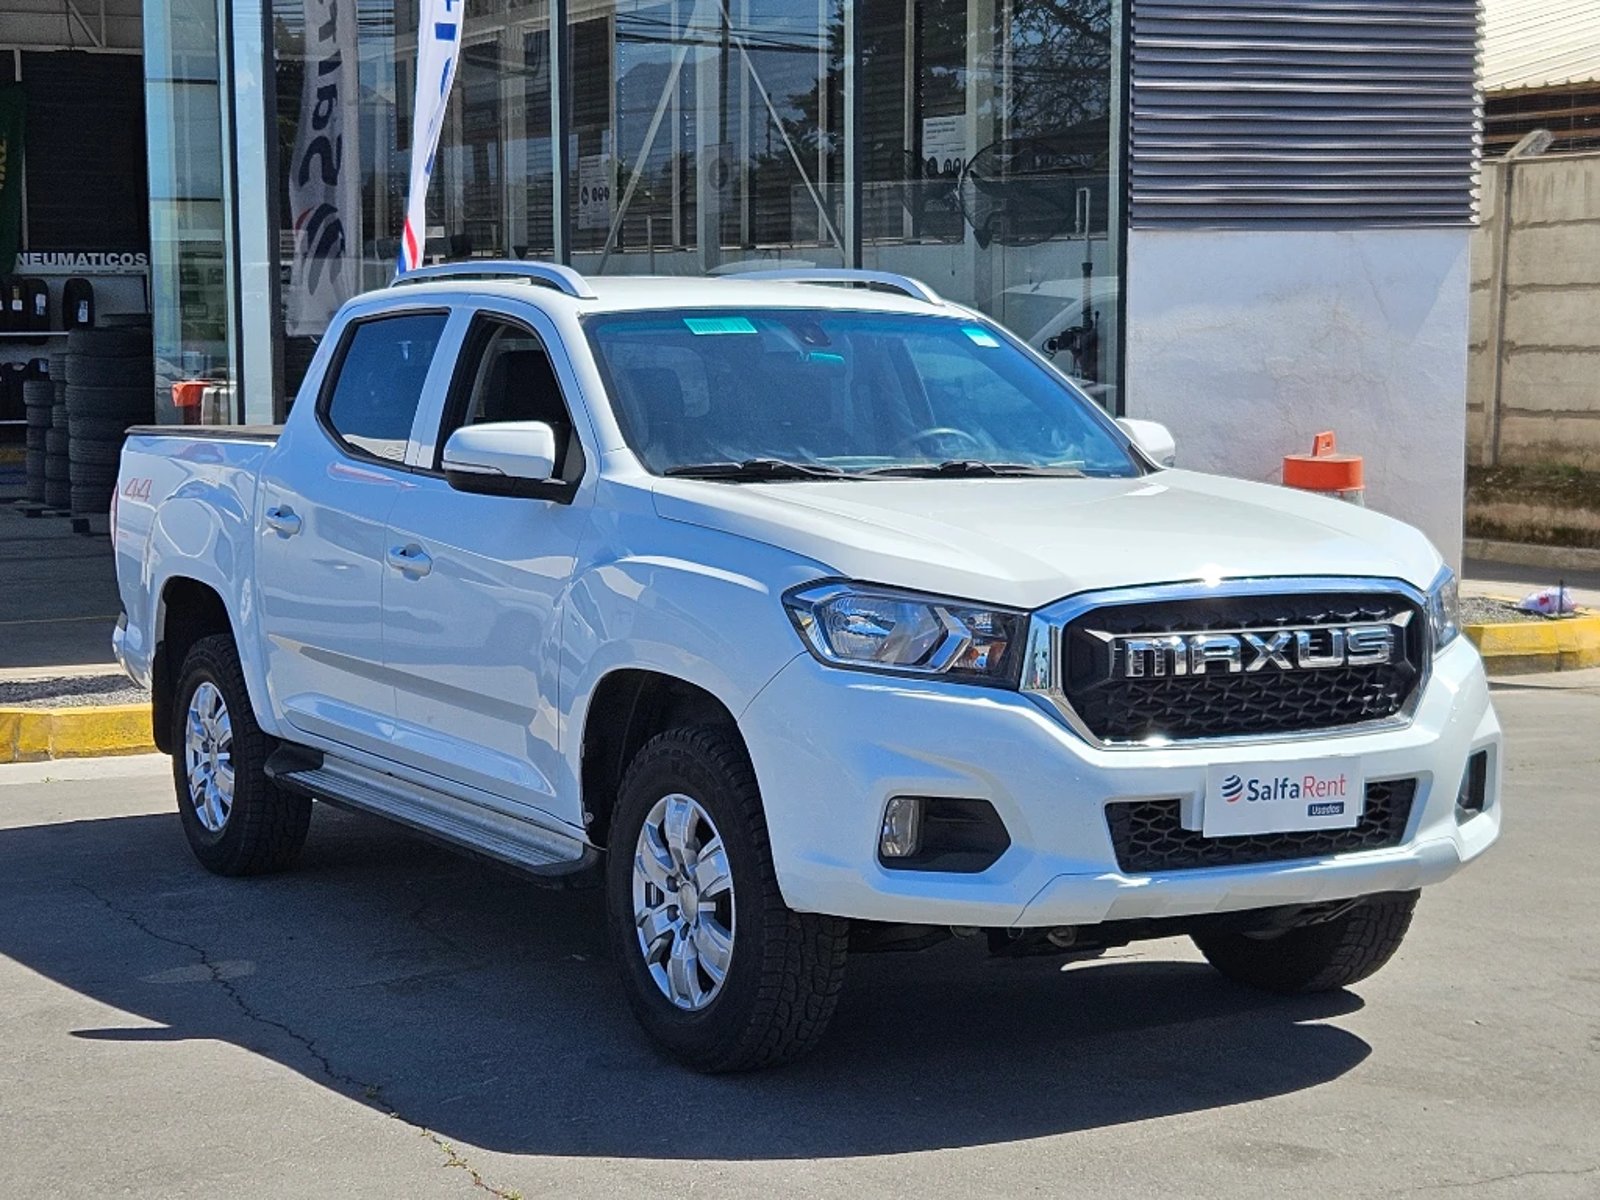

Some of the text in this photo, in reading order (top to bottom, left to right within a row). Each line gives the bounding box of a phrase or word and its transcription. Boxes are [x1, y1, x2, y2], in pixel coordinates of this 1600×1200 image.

[16, 252, 148, 266] NEUMATICOS
[1124, 624, 1391, 678] MAXUS
[1246, 774, 1347, 802] SalfaRent
[1312, 804, 1340, 815] Usados
